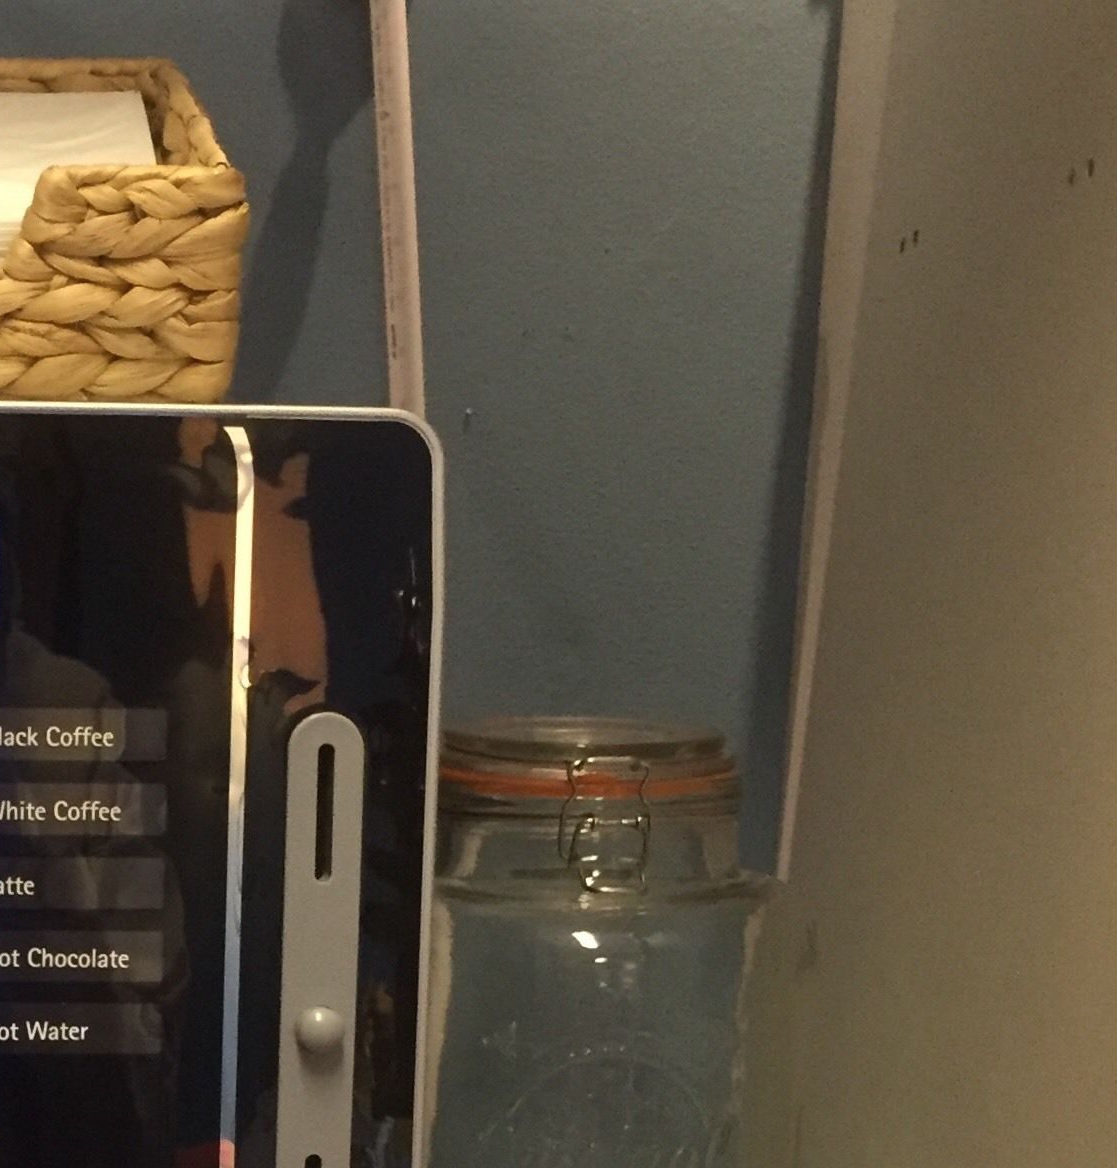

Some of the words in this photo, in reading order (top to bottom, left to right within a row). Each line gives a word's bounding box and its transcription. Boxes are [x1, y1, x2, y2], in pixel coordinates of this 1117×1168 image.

[46, 726, 114, 747] Coffee
[54, 800, 122, 821] Coffee
[27, 947, 130, 968] Chocolate
[26, 1020, 89, 1041] Water
